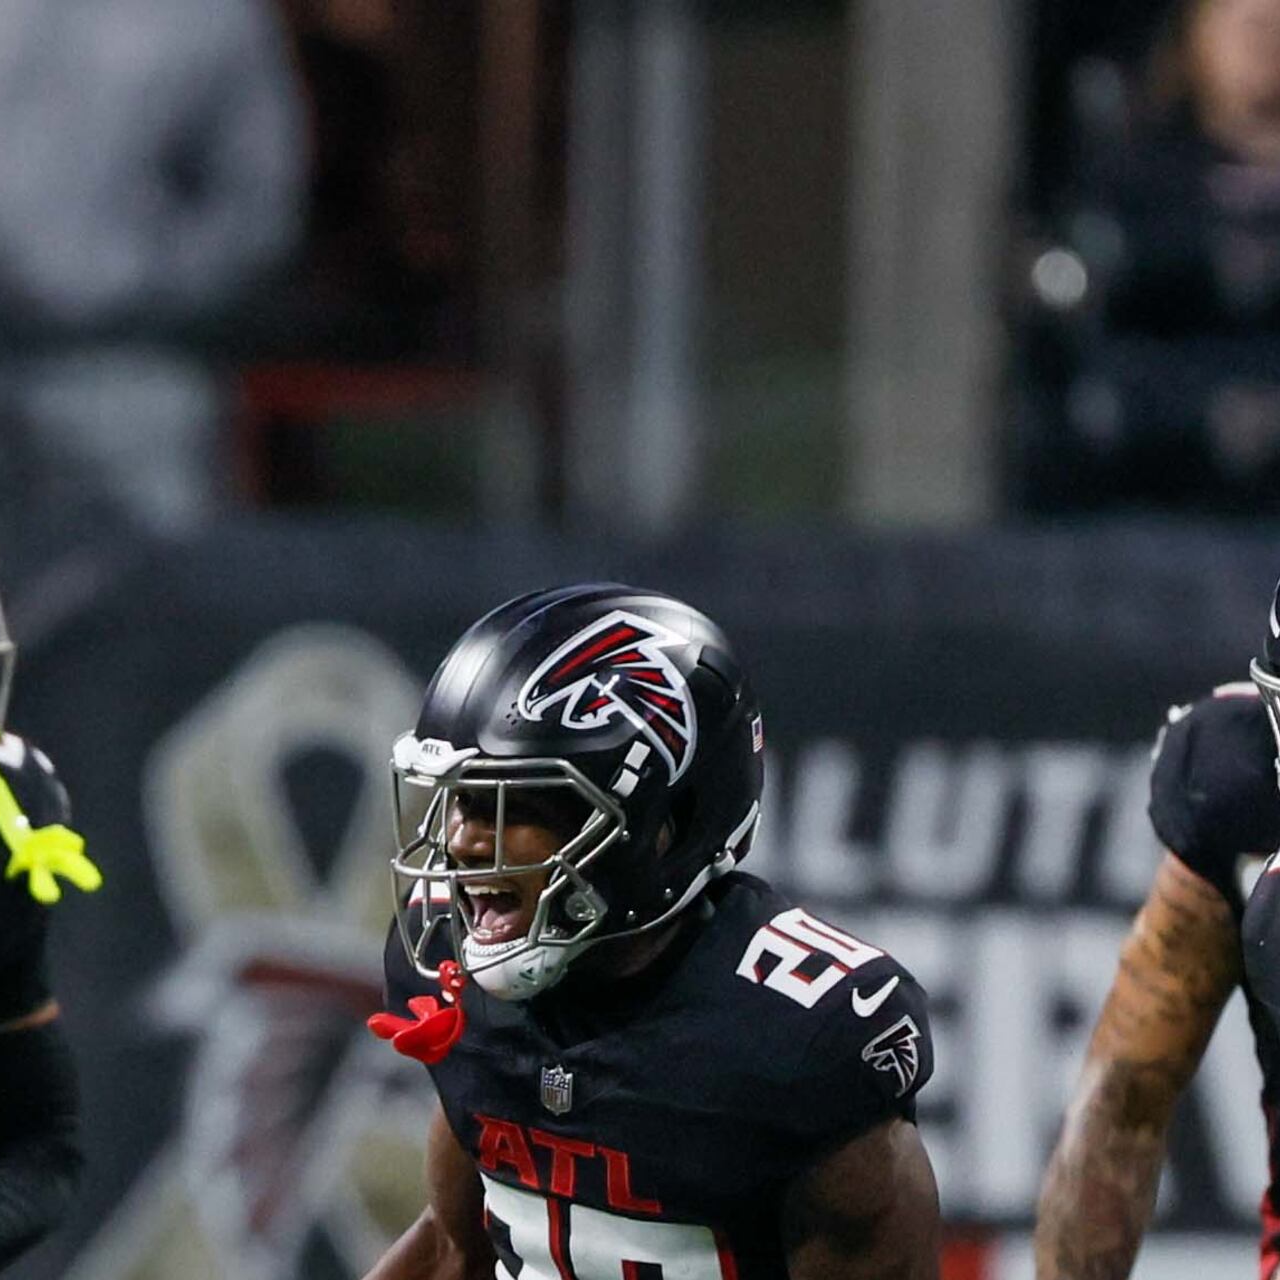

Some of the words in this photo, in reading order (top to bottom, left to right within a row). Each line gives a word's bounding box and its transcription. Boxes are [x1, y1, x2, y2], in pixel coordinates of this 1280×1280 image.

[421, 743, 442, 757] ATL
[735, 907, 892, 1010] 20
[472, 1111, 663, 1216] ATL
